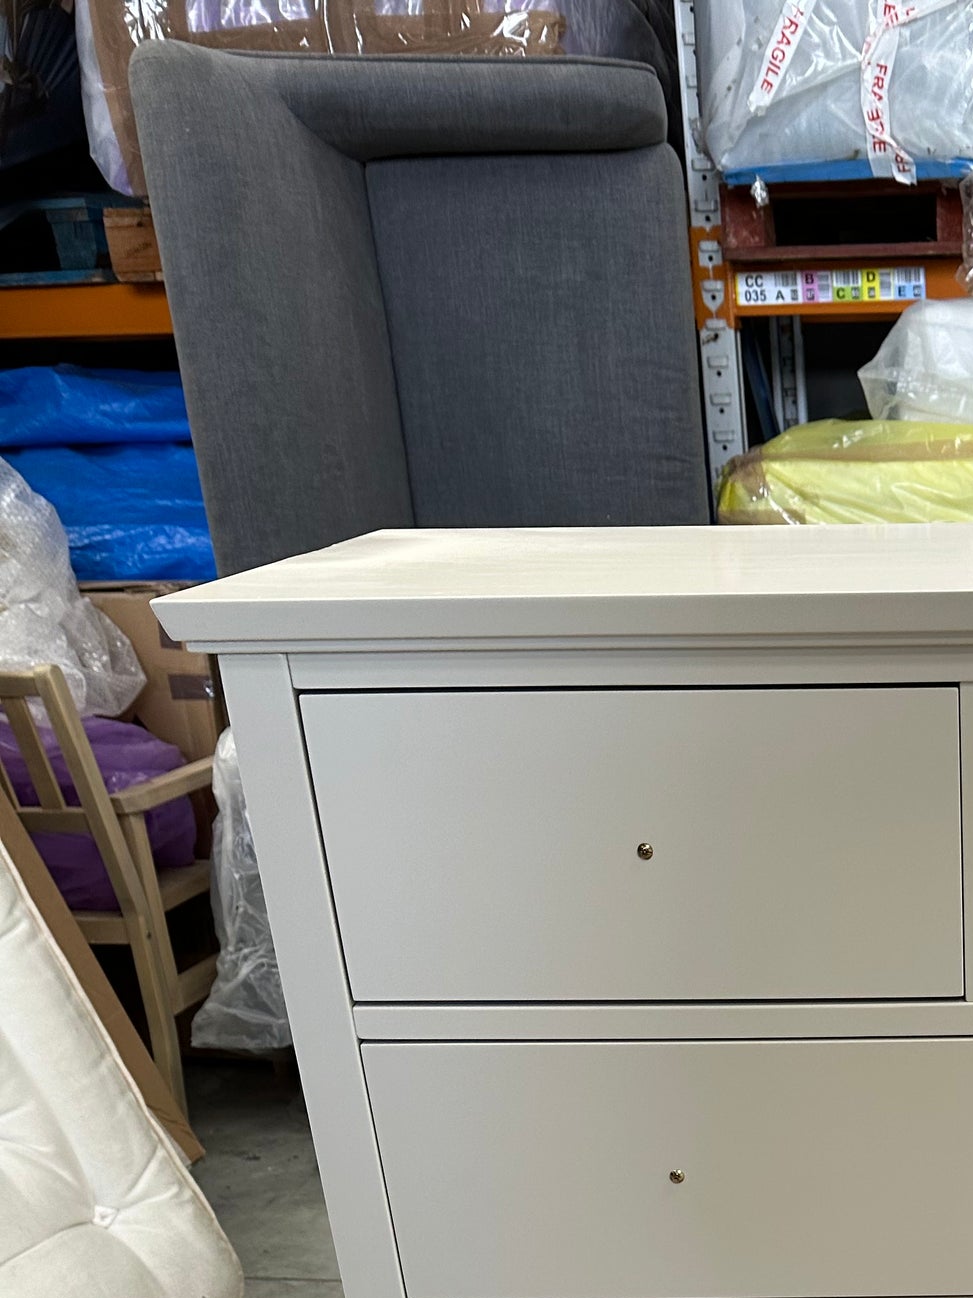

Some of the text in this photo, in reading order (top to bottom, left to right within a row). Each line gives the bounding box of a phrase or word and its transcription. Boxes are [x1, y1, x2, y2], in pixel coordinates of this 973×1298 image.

[744, 274, 764, 288] CC
[805, 273, 814, 285] B
[866, 271, 875, 283] D
[744, 290, 767, 302] 035
[775, 290, 785, 301] A
[836, 289, 845, 300] C
